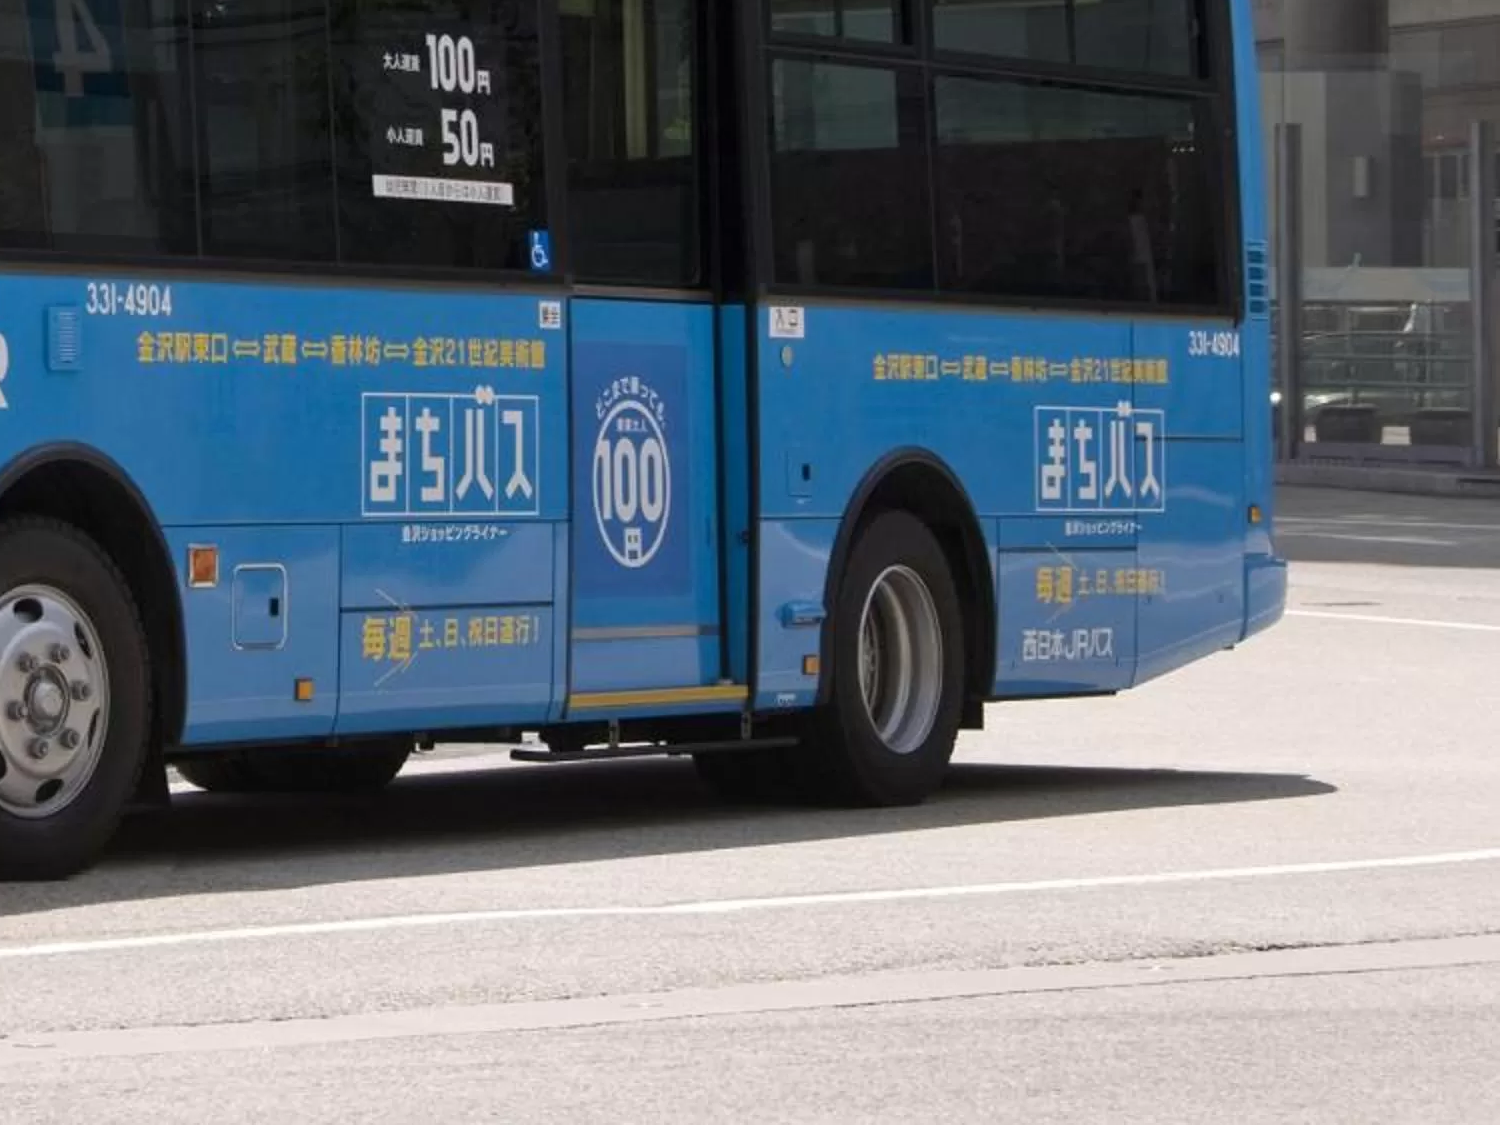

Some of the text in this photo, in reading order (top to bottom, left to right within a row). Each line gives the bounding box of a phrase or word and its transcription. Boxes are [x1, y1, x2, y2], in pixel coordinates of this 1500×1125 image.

[370, 384, 533, 502] まちバス
[1041, 401, 1160, 500] まちバス
